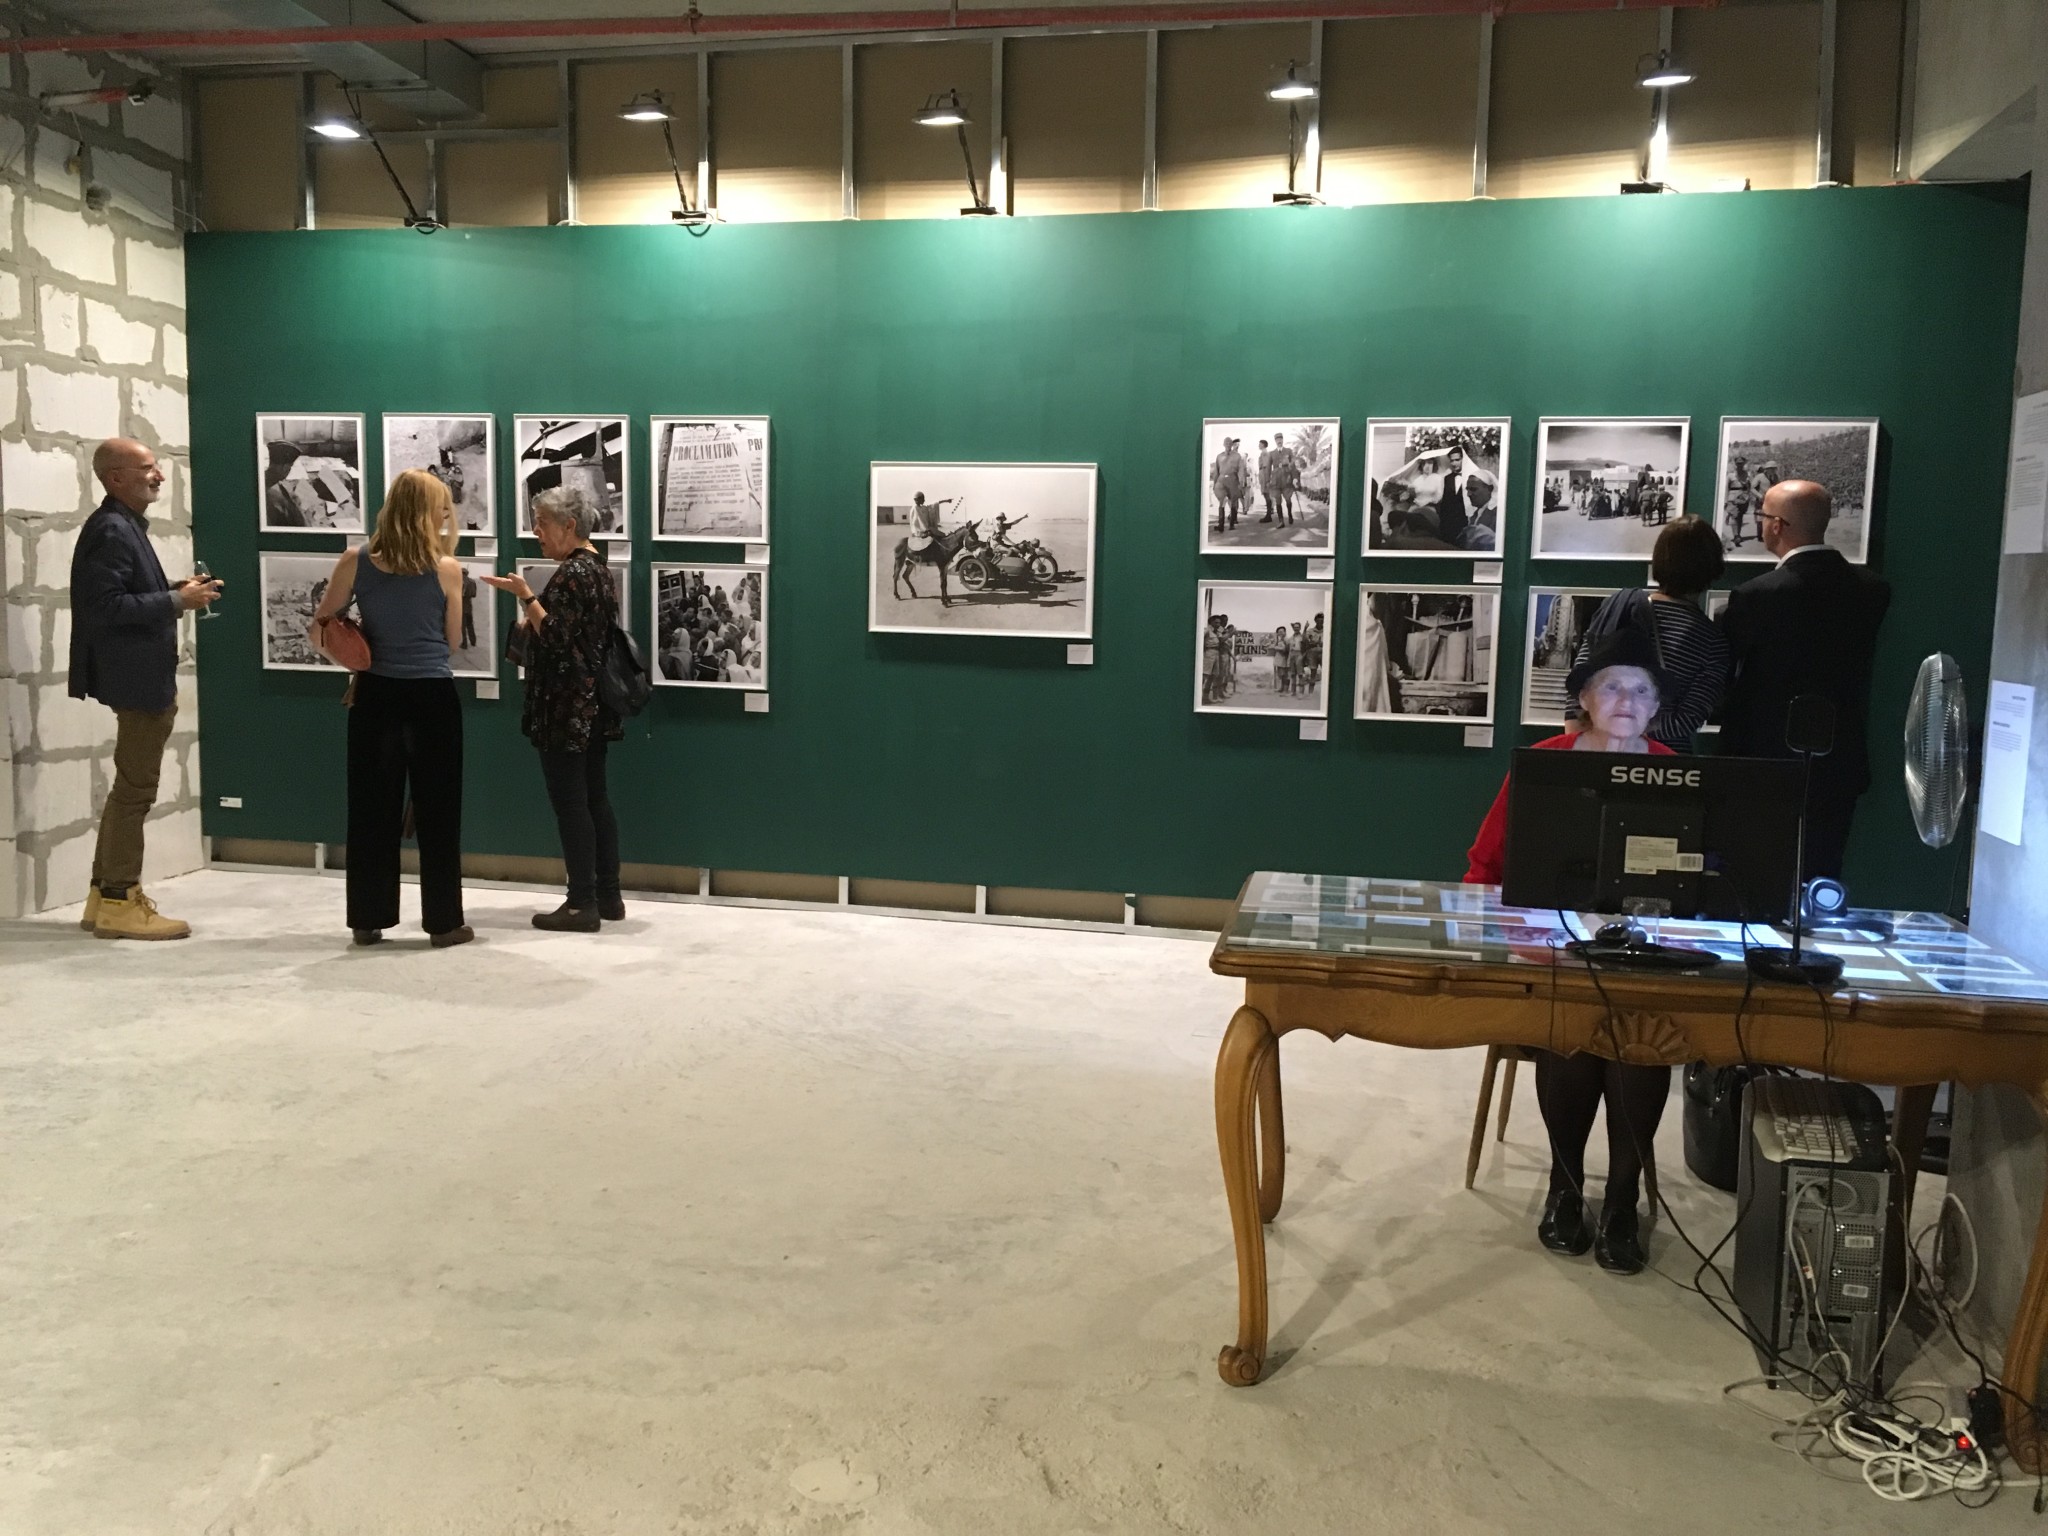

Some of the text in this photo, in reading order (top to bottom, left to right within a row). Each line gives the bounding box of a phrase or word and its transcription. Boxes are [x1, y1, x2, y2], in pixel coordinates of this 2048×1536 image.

[672, 441, 739, 461] PROCLAMATION
[1235, 645, 1268, 655] TUNIS
[1611, 766, 1701, 787] SENSE
